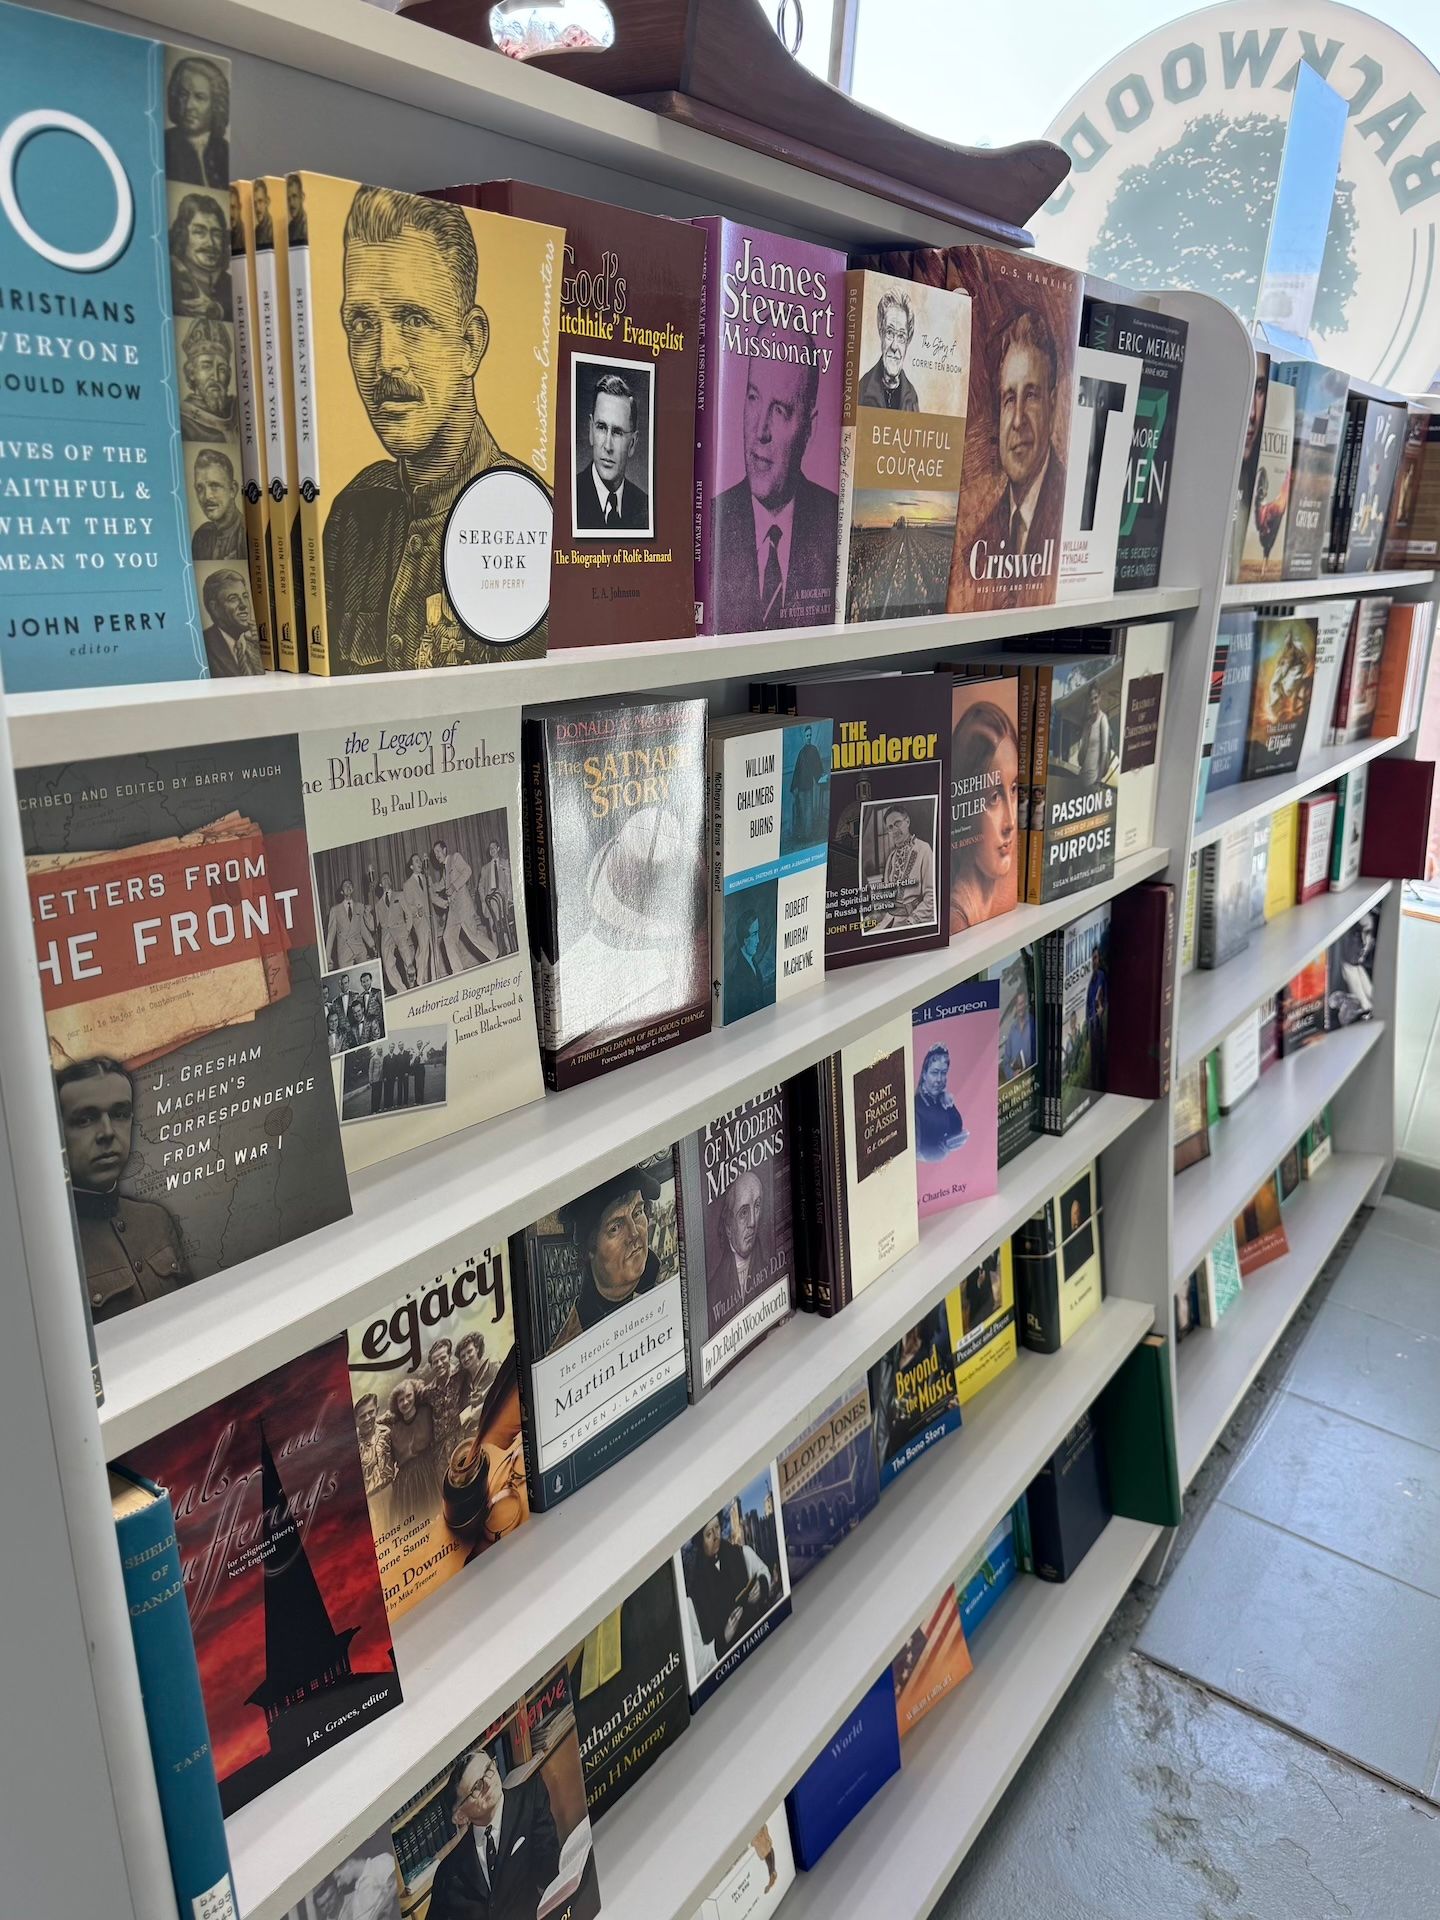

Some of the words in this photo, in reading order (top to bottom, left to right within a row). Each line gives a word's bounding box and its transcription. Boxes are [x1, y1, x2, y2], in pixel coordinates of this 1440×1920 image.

[735, 237, 827, 302] James
[1027, 272, 1074, 293] HAWKINS
[533, 239, 556, 368] Encounters
[721, 272, 835, 338] Stewart
[296, 287, 308, 388] SERGEANT
[623, 316, 685, 357] Evangelist
[846, 289, 858, 355] BEAUTIFUL
[723, 322, 833, 373] Missionary
[1118, 331, 1143, 353] ERIC
[1145, 337, 1185, 362] METAXAS
[697, 343, 707, 411] MISSIONARY
[912, 358, 933, 369] CORRIE
[934, 361, 945, 372] TEN
[77, 380, 141, 400] KNOW
[843, 361, 854, 418] COURAGE
[301, 394, 311, 442] YORK
[531, 367, 549, 472] Christian
[65, 445, 93, 461] OF
[103, 446, 147, 464] THE
[872, 425, 950, 453] BEAUTIFUL
[1131, 428, 1159, 449] MORE
[876, 455, 944, 483] COURAGE
[135, 481, 151, 500] &
[85, 518, 154, 535] THEY
[458, 530, 548, 545] SERGEANT
[694, 513, 702, 562] STEWART
[0, 554, 65, 571] MEAN
[76, 553, 105, 570] TO
[114, 552, 158, 569] YOU
[482, 555, 527, 570] YORK
[554, 549, 570, 565] The
[571, 548, 611, 568] Biography
[613, 548, 622, 563] of
[622, 549, 642, 564] Rolfe
[644, 549, 672, 563] Barnard
[969, 539, 1055, 581] Criswell
[1061, 553, 1089, 564] TYNDALE
[1063, 541, 1088, 551] WILLIAM
[480, 579, 501, 590] JOHN
[502, 578, 525, 590] PERRY
[7, 617, 80, 638] JOHN
[94, 612, 167, 634] PERRY
[70, 643, 119, 656] editor
[345, 732, 370, 755] the
[378, 729, 432, 756] Legacy
[442, 720, 460, 749] of
[840, 720, 867, 743] THE
[328, 745, 435, 791] Blackwood
[440, 738, 516, 774] Brothers
[745, 754, 775, 778] WILLIAM
[81, 787, 108, 802] AND
[116, 780, 165, 796] EDITED
[172, 777, 188, 789] BY
[195, 771, 234, 786] BARRY
[241, 765, 282, 779] WAUGH
[591, 777, 670, 821] STORY
[737, 785, 774, 811] CHALMERS
[371, 798, 388, 817] By
[391, 791, 415, 813] Paul
[417, 790, 448, 809] Davis
[1051, 791, 1102, 825] PASSION
[1105, 789, 1113, 806] &
[750, 815, 774, 839] BURNS
[1050, 827, 1112, 866] PURPOSE
[32, 874, 165, 923] ETTERS
[185, 854, 266, 890] FROM
[825, 889, 839, 900] The
[840, 885, 860, 899] Story
[869, 880, 895, 892] William
[840, 893, 869, 907] Spiritual
[870, 890, 896, 902] Revival
[785, 896, 809, 920] ROBERT
[834, 906, 857, 918] Russia
[133, 888, 300, 966] FRONT
[783, 925, 808, 950] MURRAY
[825, 922, 848, 936] JOHN
[407, 993, 460, 1018] Authorized
[461, 978, 512, 1002] Biographies
[513, 971, 523, 988] of
[452, 1010, 473, 1024] Cecil
[474, 993, 517, 1018] Blackwood
[935, 1000, 987, 1019] Spurgeon
[454, 1028, 479, 1045] James
[480, 1009, 522, 1034] Blackwood
[613, 1037, 637, 1052] DRAMA
[647, 1021, 681, 1039] RELIGIOUS
[152, 1073, 170, 1091] J.
[180, 1046, 262, 1083] GRESHAM
[156, 1075, 247, 1116] MACHEN'S
[159, 1077, 315, 1142] CORRESPONDENCE
[864, 1096, 897, 1125] FRANCIS
[869, 1084, 892, 1106] SAINT
[704, 1141, 722, 1168] OF
[722, 1100, 784, 1153] MODERN
[876, 1109, 899, 1134] ASSISI
[163, 1138, 211, 1167] FROM
[165, 1158, 226, 1191] WORLD
[234, 1143, 268, 1166] WAR
[705, 1129, 785, 1206] MISSIONS
[922, 1188, 950, 1203] Charles
[951, 1183, 967, 1198] Ray
[559, 1362, 576, 1378] The
[580, 1339, 610, 1364] Heroic
[613, 1312, 654, 1340] Boldness
[657, 1301, 666, 1315] of
[723, 1324, 743, 1356] Ralph
[743, 1288, 787, 1339] Woodworth
[554, 1365, 615, 1419] Martin
[619, 1326, 673, 1372] Luther
[895, 1343, 940, 1398] Beyond
[562, 1411, 607, 1448] STEVEN
[625, 1366, 671, 1403] LAWSON
[917, 1371, 953, 1413] Music
[783, 1399, 867, 1485] LLOYD-JONES
[892, 1454, 906, 1472] The
[906, 1440, 925, 1456] Bono
[925, 1423, 946, 1444] Story
[391, 1518, 431, 1549] Trotman
[403, 1514, 415, 1527] on
[227, 1558, 239, 1570] for
[239, 1541, 271, 1563] religious
[271, 1525, 295, 1544] liberty
[228, 1565, 247, 1579] New
[248, 1545, 276, 1569] England
[402, 1539, 460, 1587] Downing
[403, 1532, 430, 1558] Sanny
[151, 1565, 170, 1581] OF
[714, 1650, 742, 1681] COLIN
[743, 1621, 771, 1654] HAMER
[622, 1650, 681, 1717] Edwards
[306, 1730, 323, 1747] J.R.
[325, 1707, 360, 1733] Graves,
[361, 1688, 390, 1710] editor
[586, 1745, 610, 1773] NEW
[612, 1687, 666, 1750] BIOGRAPHY
[609, 1765, 622, 1787] H
[624, 1721, 667, 1773] Murray
[830, 1720, 865, 1759] World
[175, 1743, 209, 1773] TARR
